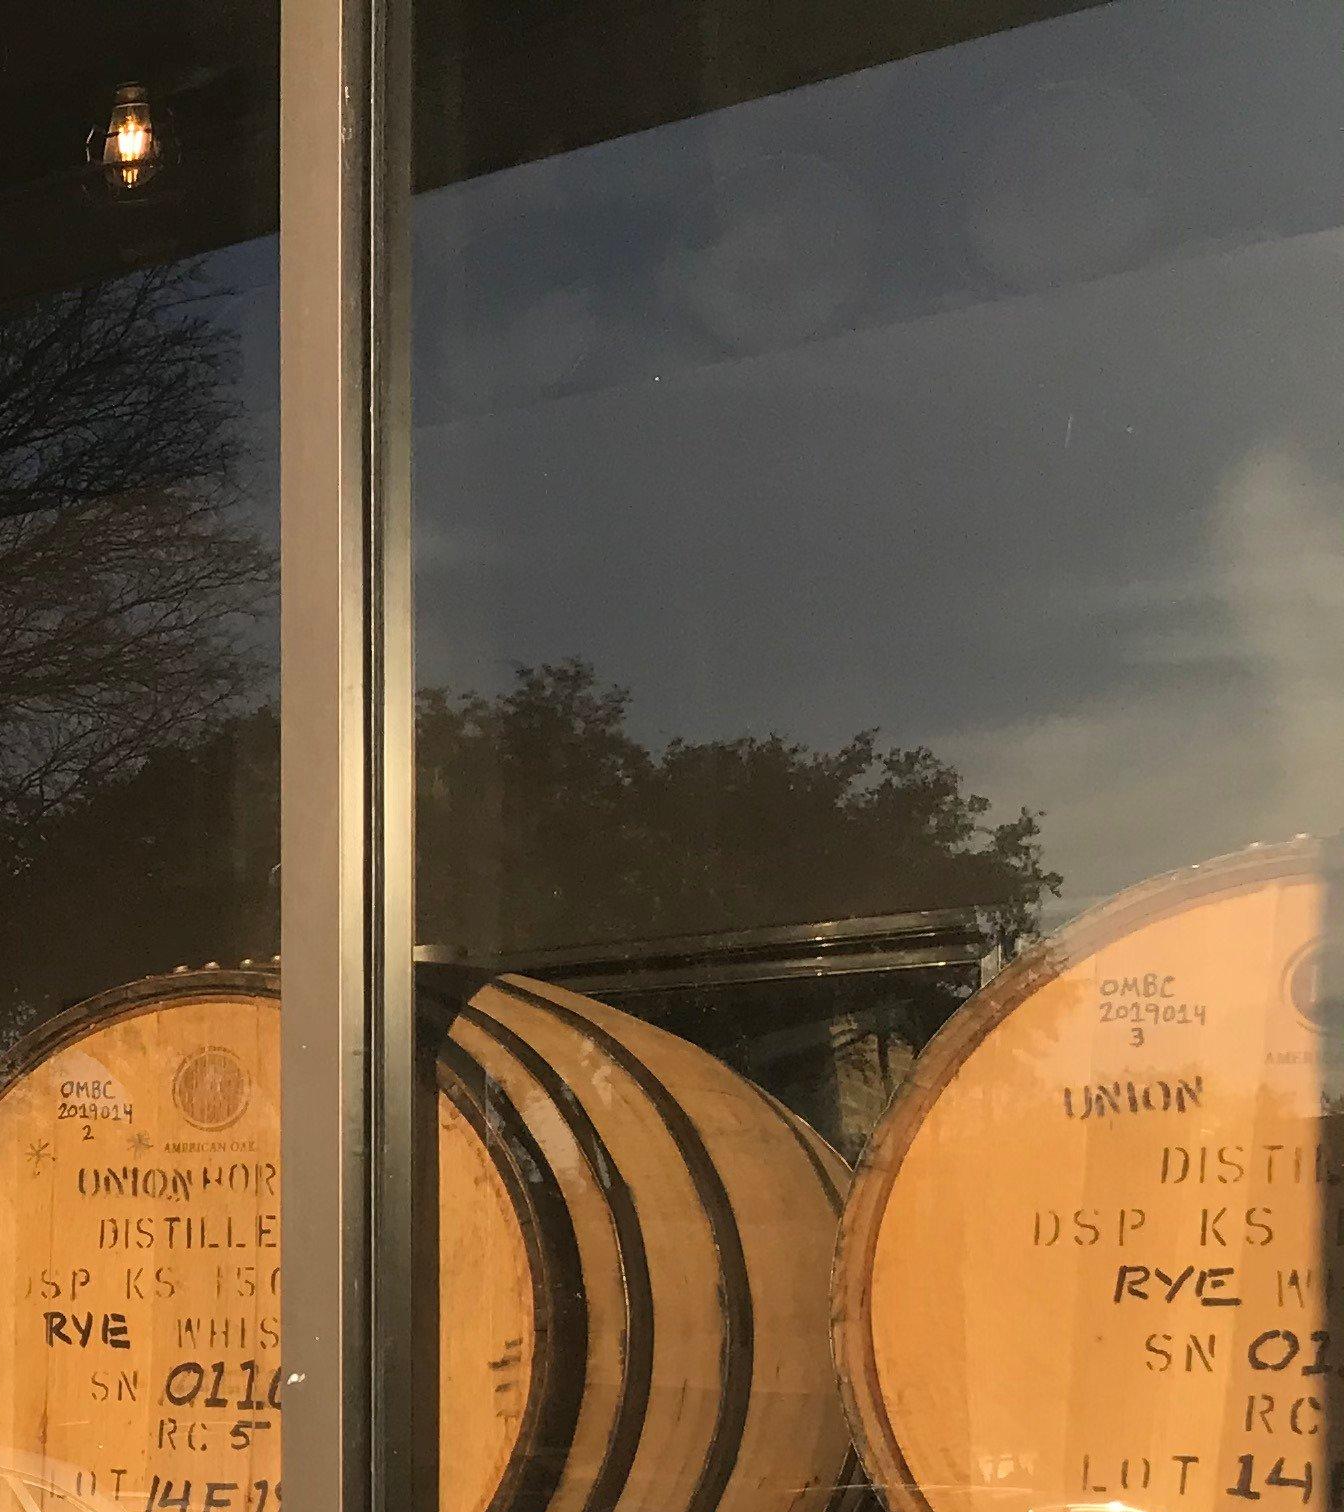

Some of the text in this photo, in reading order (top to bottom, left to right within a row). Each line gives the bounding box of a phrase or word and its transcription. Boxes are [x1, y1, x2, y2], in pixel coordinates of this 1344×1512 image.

[1099, 973, 1175, 998] OMBC
[1099, 1002, 1207, 1025] 2019014
[1129, 1027, 1145, 1047] 3
[60, 1080, 115, 1100] OMBC
[1064, 1076, 1203, 1119] UNION
[58, 1102, 133, 1124] 2019014
[82, 1124, 94, 1141] 2
[164, 1140, 256, 1153] AMERICAN OAK
[78, 1166, 193, 1202] UNION
[1034, 1208, 1273, 1246] DSP KS
[25, 1267, 176, 1300] SP KS
[1114, 1266, 1242, 1307] RYE
[43, 1311, 131, 1349] RYE
[1145, 1334, 1215, 1372] SN
[91, 1370, 138, 1402] SN
[1246, 1395, 1320, 1434] RC
[158, 1418, 207, 1451] RC
[1082, 1455, 1200, 1496] LOT
